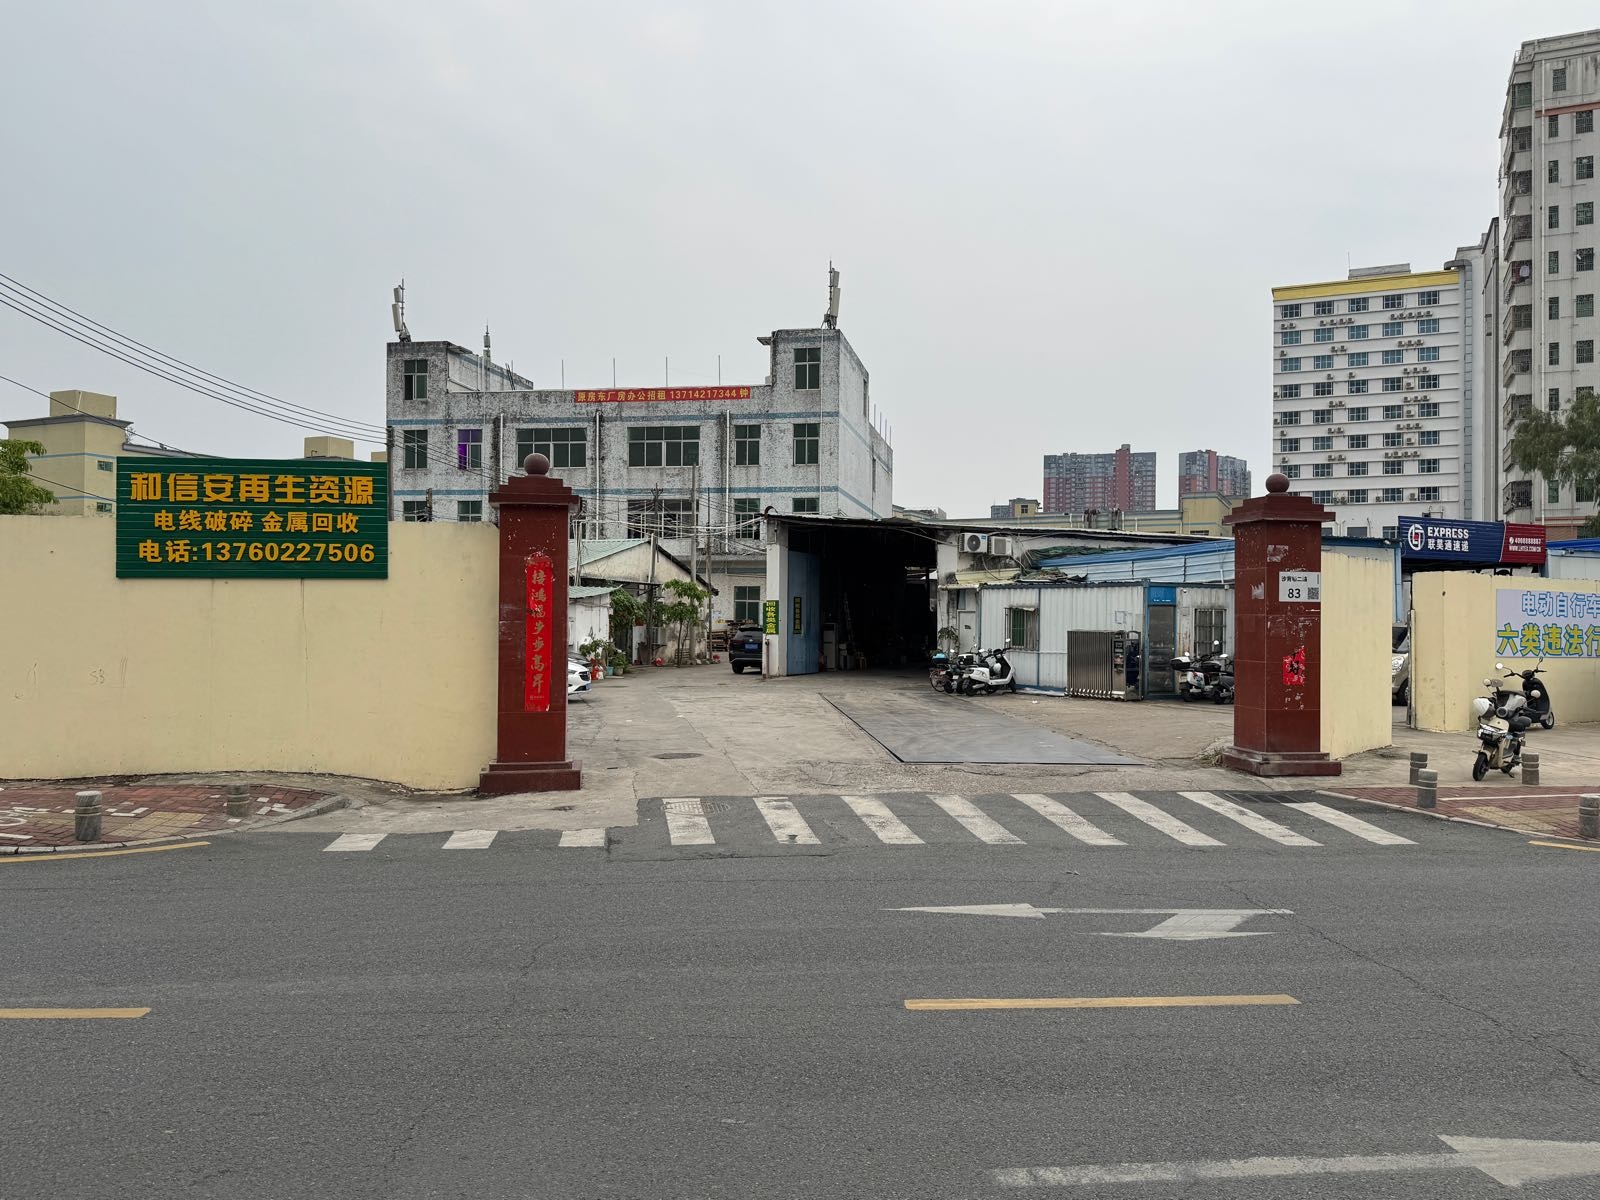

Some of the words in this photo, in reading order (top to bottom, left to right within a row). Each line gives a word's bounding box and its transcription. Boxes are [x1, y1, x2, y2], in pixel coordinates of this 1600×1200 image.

[577, 389, 666, 402] 原房东厂房办公招租
[670, 388, 737, 400] 13714217344
[739, 387, 749, 399] 钟
[130, 472, 375, 505] 和信安再生资源
[154, 509, 254, 533] 电线破碎
[260, 511, 360, 534] 金属回收
[1427, 526, 1470, 540] EXPRESS
[138, 539, 375, 564] 电话:13760227506
[1427, 538, 1470, 552] 联昊通速递
[1287, 587, 1302, 599] 83
[1521, 590, 1600, 619] 电动自行车
[1496, 622, 1600, 657] 六类违法行
